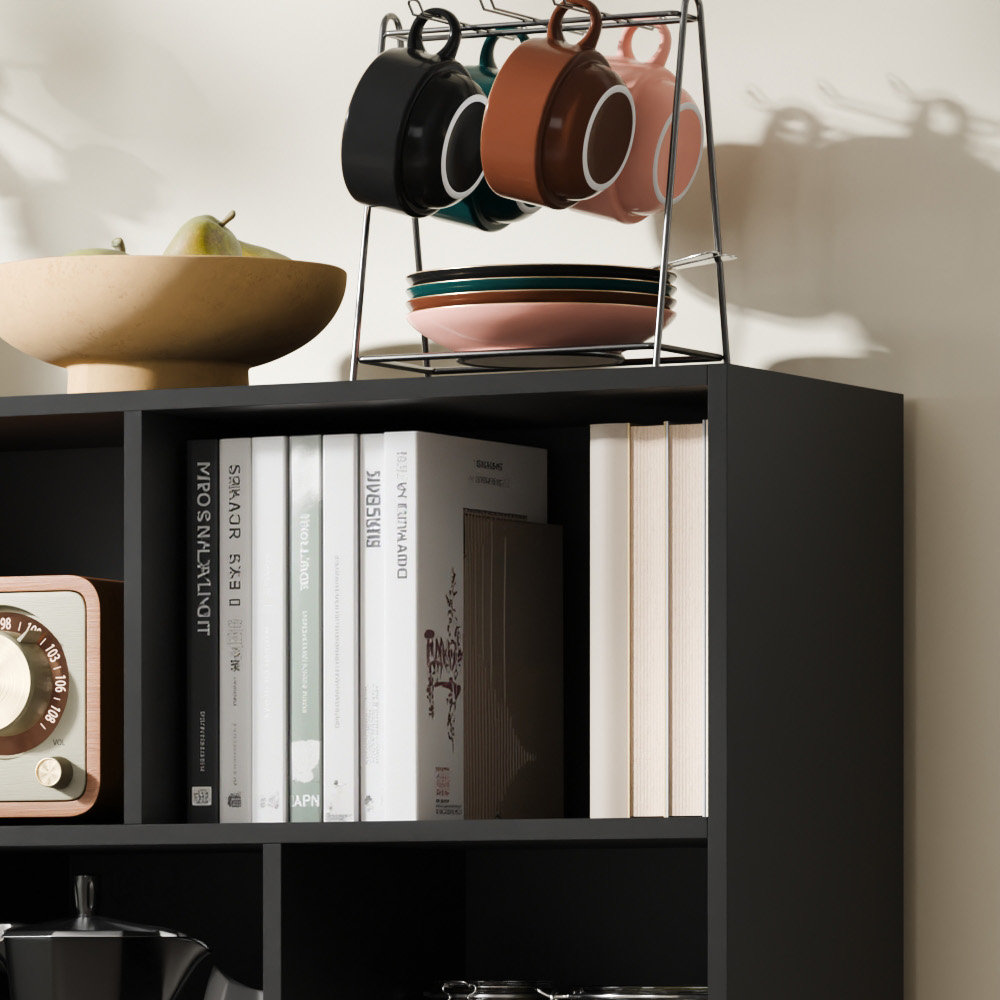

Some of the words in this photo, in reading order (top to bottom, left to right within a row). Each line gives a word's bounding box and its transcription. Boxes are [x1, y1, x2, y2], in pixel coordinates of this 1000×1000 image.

[0, 617, 12, 631] 98
[44, 643, 61, 663] 103
[54, 674, 67, 694] 106
[44, 704, 62, 724] 108
